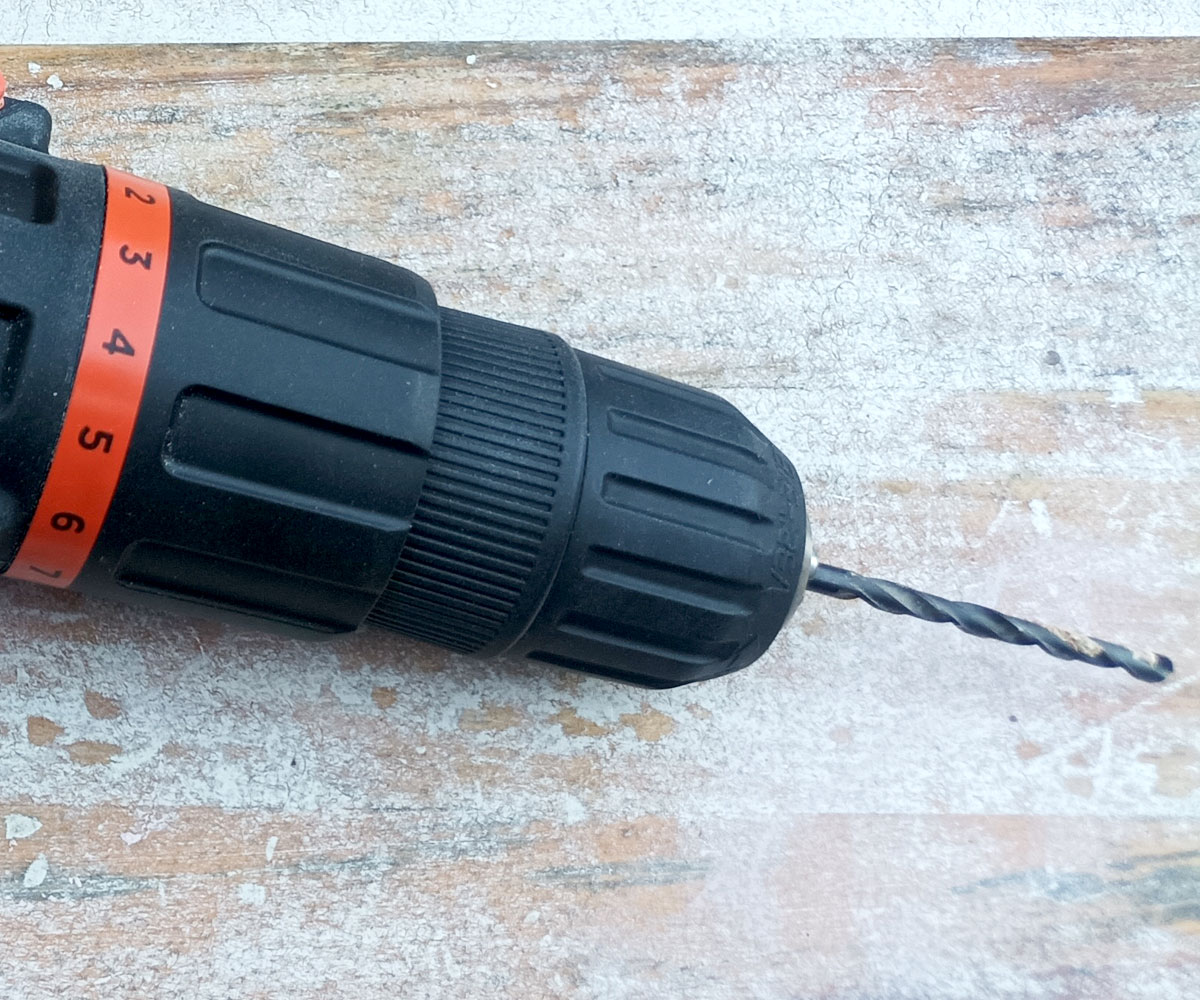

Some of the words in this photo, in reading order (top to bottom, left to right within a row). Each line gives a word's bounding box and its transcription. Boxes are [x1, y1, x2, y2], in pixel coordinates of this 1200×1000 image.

[124, 187, 156, 205] 2
[120, 244, 152, 270] 3
[102, 328, 135, 357] 4
[78, 426, 114, 454] 5
[51, 511, 85, 534] 6
